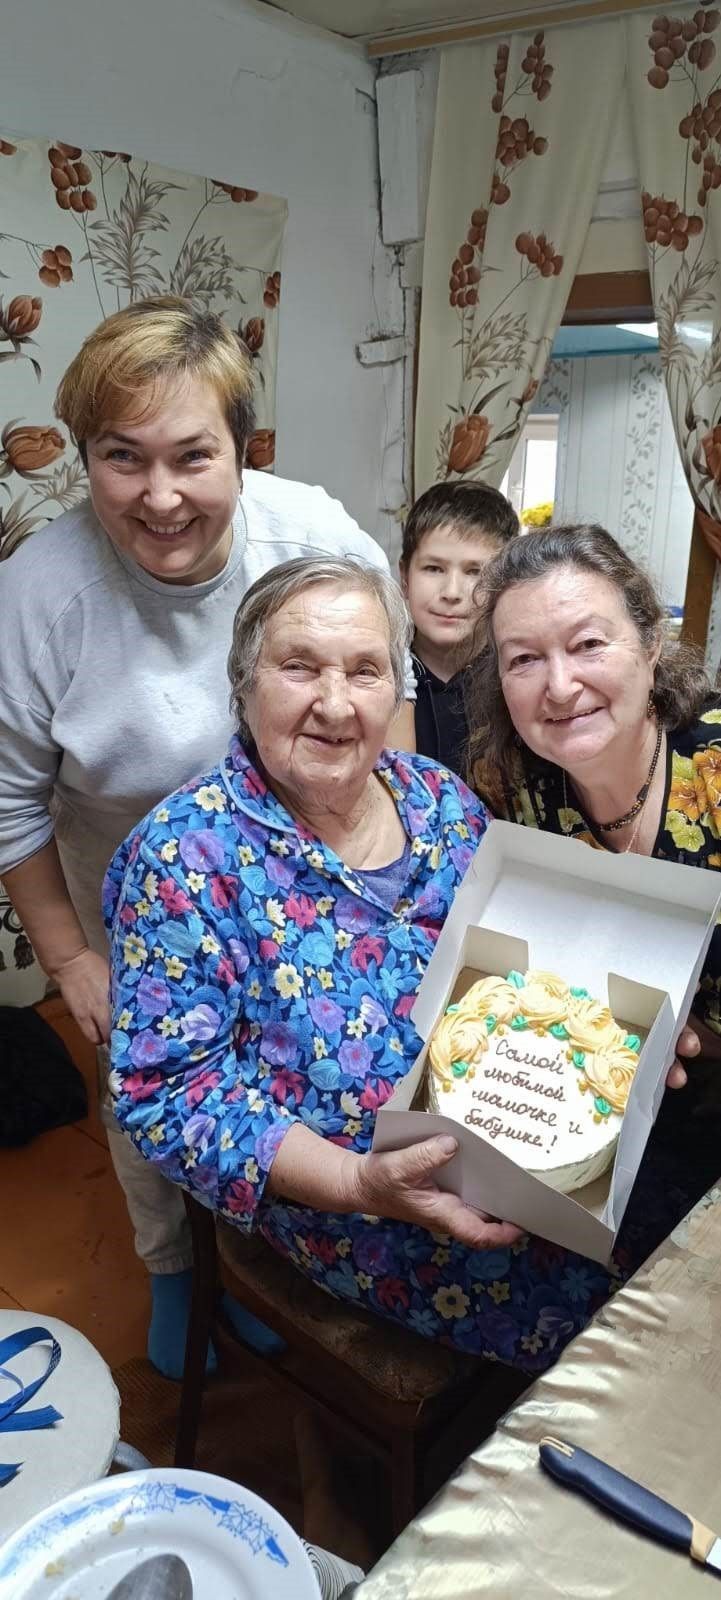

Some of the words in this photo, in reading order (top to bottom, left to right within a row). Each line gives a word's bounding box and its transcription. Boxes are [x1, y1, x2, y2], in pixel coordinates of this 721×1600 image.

[496, 1039, 564, 1075] Самой
[484, 1068, 566, 1102] любимой
[472, 1089, 557, 1127] мамочке
[568, 1121, 583, 1135] и
